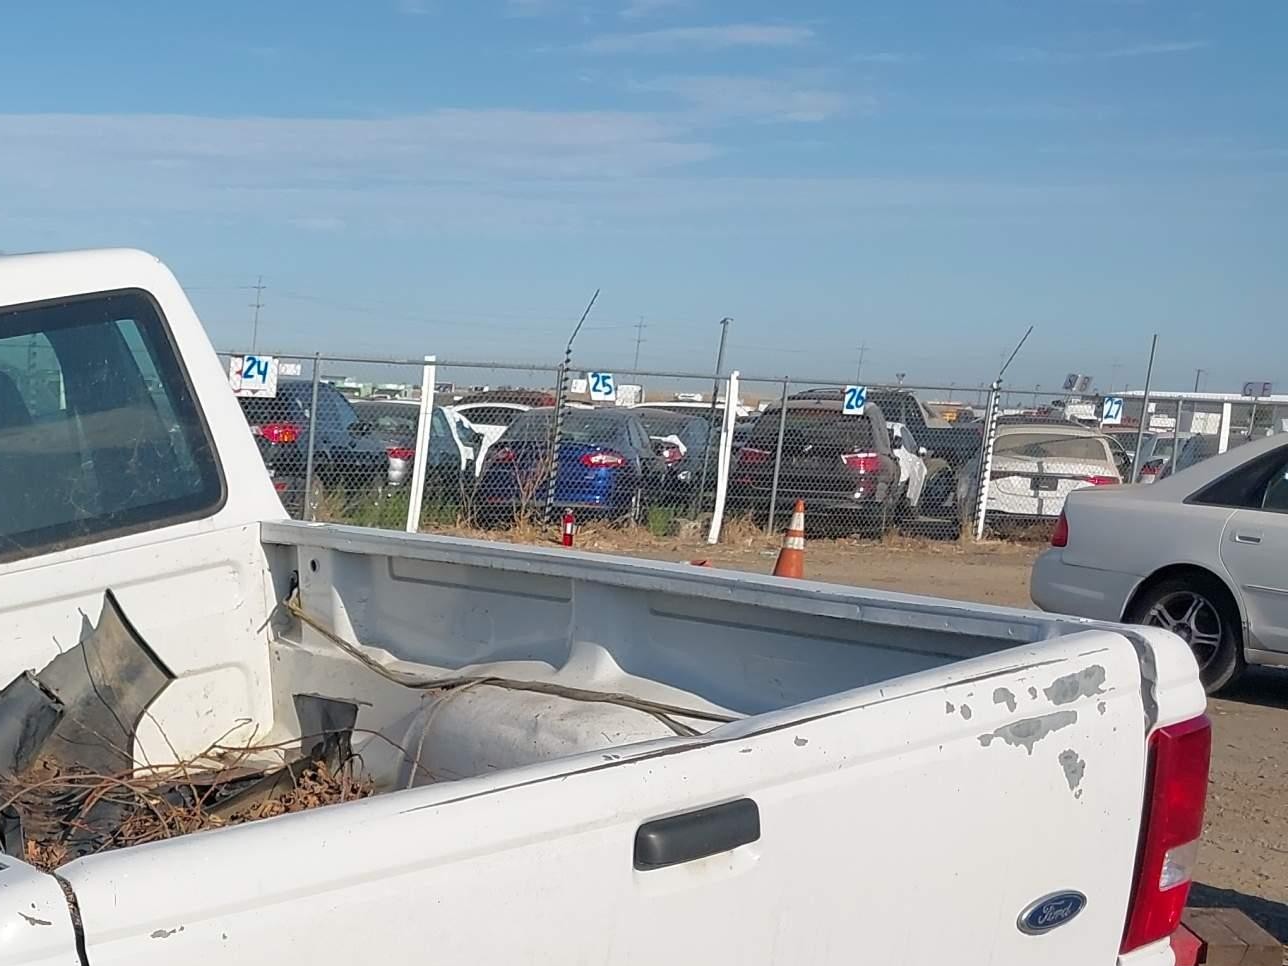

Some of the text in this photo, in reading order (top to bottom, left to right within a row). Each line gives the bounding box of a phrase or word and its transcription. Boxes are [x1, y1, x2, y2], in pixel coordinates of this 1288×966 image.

[243, 357, 268, 384] 24
[591, 372, 613, 395] 25
[846, 387, 865, 410] 26
[1103, 396, 1123, 419] 27
[1038, 900, 1073, 924] Ford
